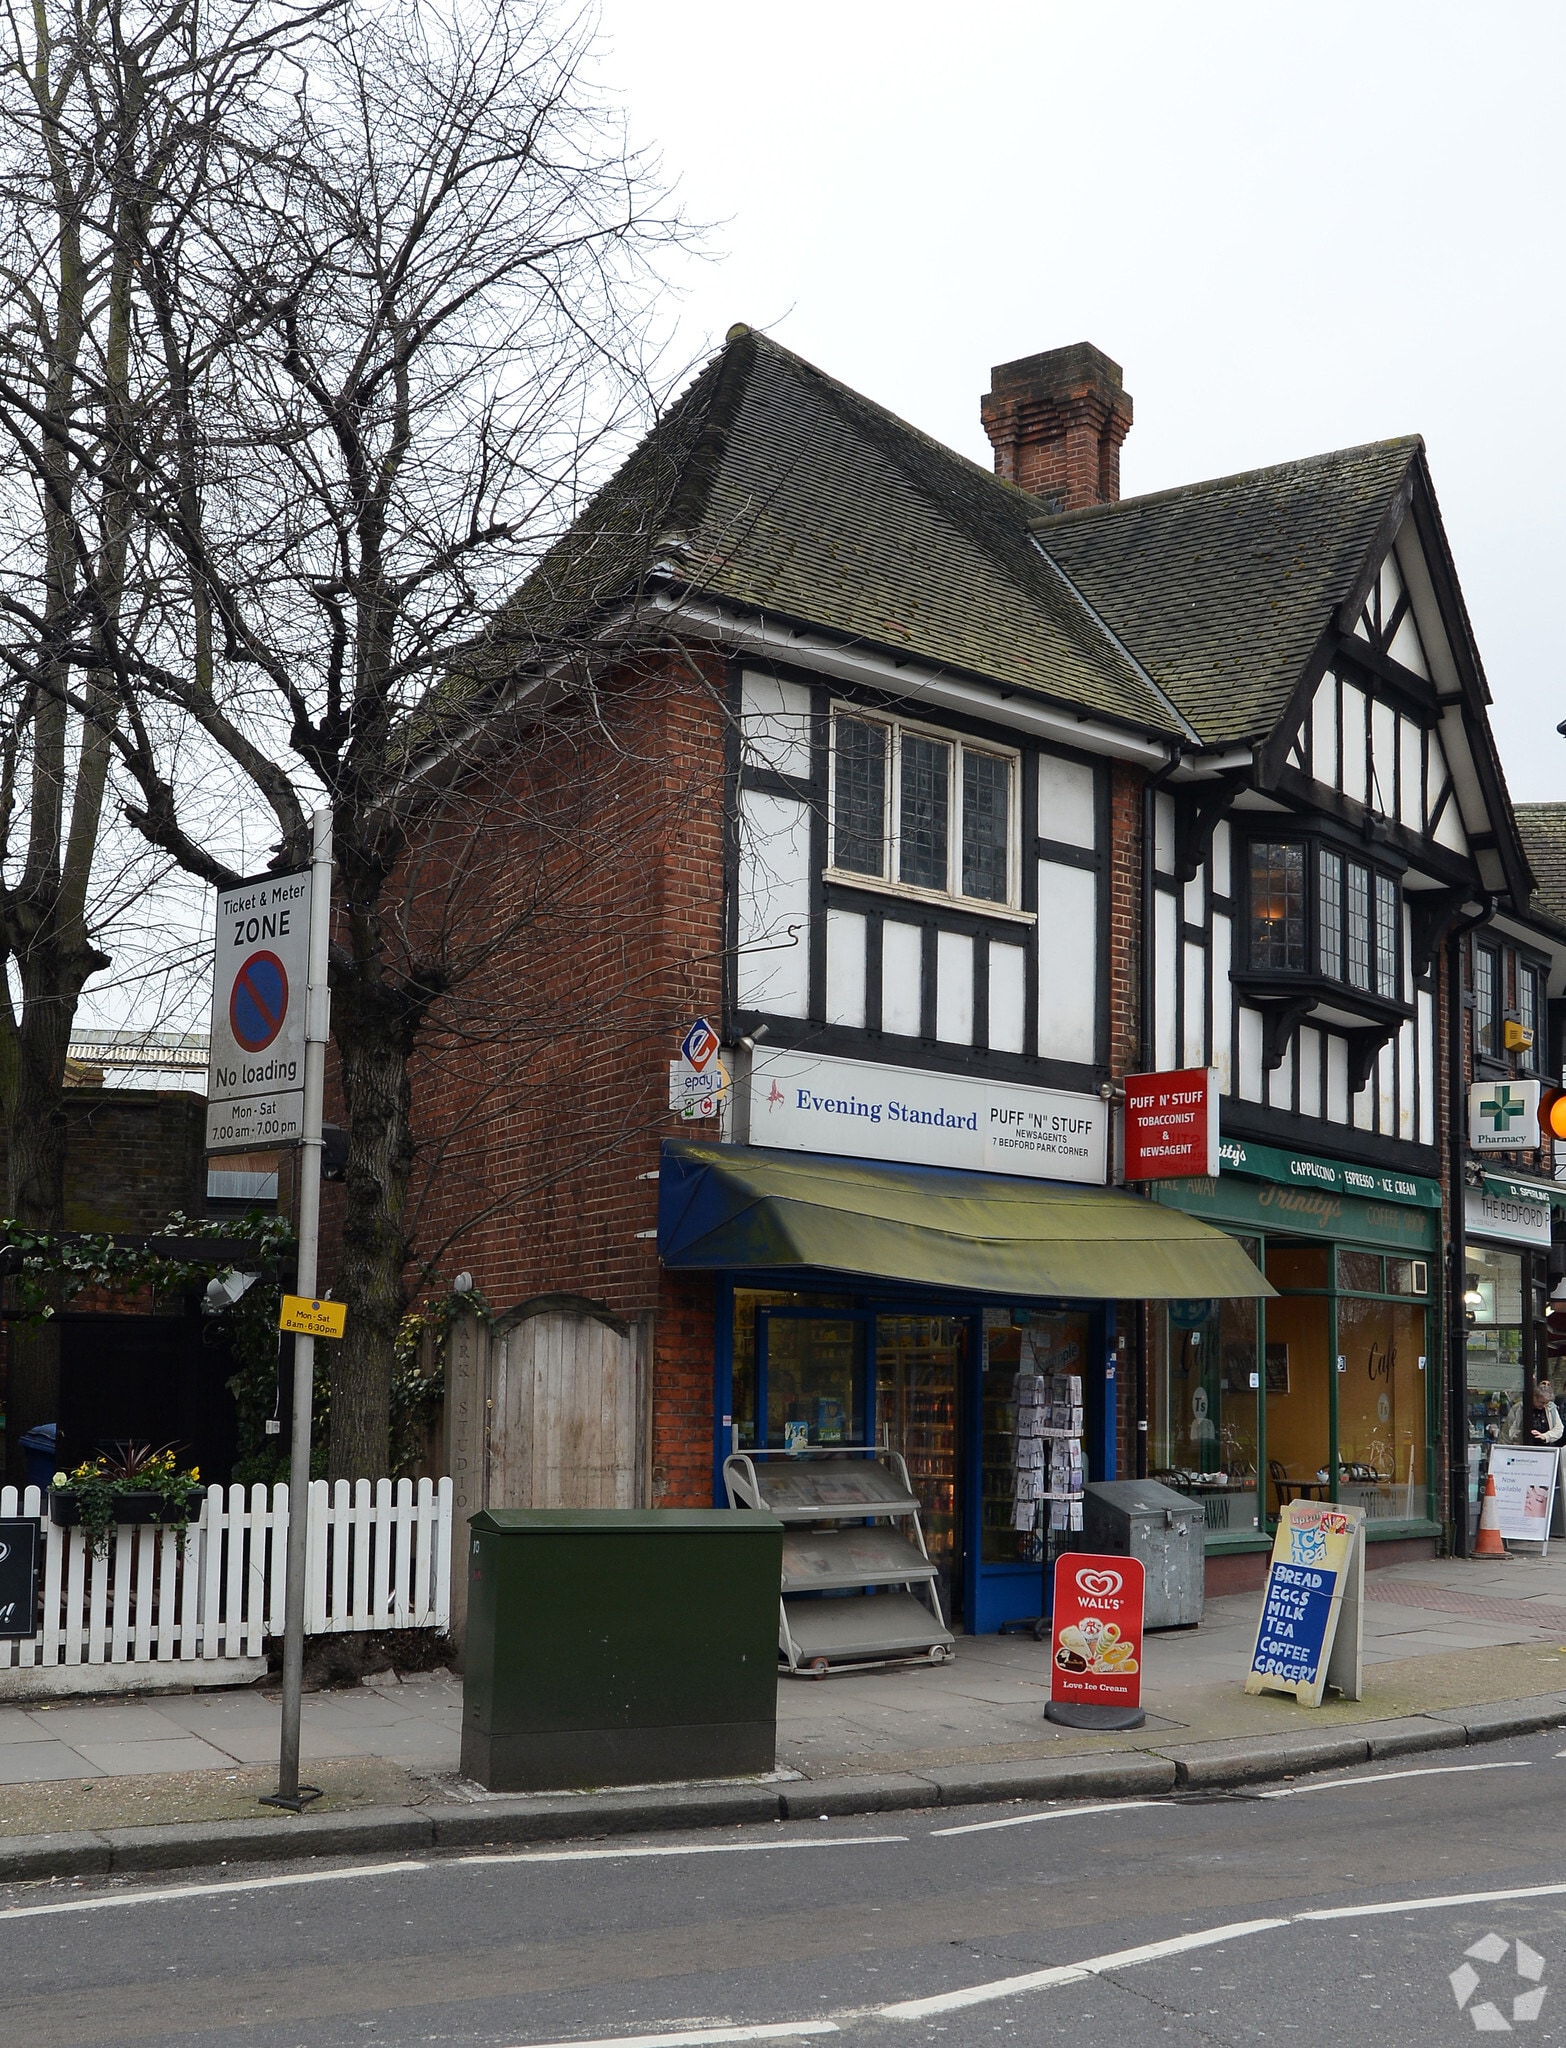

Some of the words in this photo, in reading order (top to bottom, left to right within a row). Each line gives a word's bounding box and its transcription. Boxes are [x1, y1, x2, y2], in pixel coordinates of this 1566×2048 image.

[224, 894, 256, 915] Ticket
[260, 891, 267, 906] &
[272, 885, 305, 903] Meter
[234, 910, 290, 946] ZONE
[216, 1067, 237, 1088] No
[243, 1060, 297, 1084] loading
[685, 1074, 713, 1091] epay
[232, 1106, 252, 1119] Mon
[260, 1101, 276, 1115] Sat
[796, 1089, 882, 1123] Evening
[888, 1101, 978, 1131] Standard
[1130, 1096, 1155, 1109] PUFF
[1172, 1091, 1203, 1105] STUFF
[990, 1108, 1025, 1126] PUFF
[1052, 1116, 1093, 1135] STUFF
[1137, 1112, 1195, 1127] TOBACCONIST
[212, 1126, 234, 1140] 7.00
[235, 1127, 250, 1138] am
[257, 1120, 279, 1135] 7.00
[281, 1121, 297, 1135] pm
[1016, 1129, 1067, 1144] NEWSAGENTS
[1162, 1131, 1169, 1140] &
[1478, 1134, 1526, 1145] Pharmacy
[992, 1137, 997, 1146] 7
[999, 1138, 1035, 1151] BEDFORD
[1036, 1143, 1057, 1153] PARK
[1058, 1145, 1089, 1157] CORNER
[1140, 1144, 1192, 1157] NEWSAGENT
[1291, 1160, 1335, 1182] CAPPUCCINO
[1345, 1171, 1375, 1189] ESPRESSO
[1382, 1178, 1393, 1192] ICE
[1394, 1181, 1417, 1196] CREAM
[1187, 1179, 1218, 1198] AWAY
[1510, 1186, 1519, 1195] D.
[1367, 1206, 1399, 1228] COFFEE
[1403, 1209, 1427, 1232] SHOP
[1482, 1198, 1498, 1219] THE
[1501, 1202, 1543, 1228] BEDFORD
[296, 1311, 312, 1320] Mon
[317, 1314, 330, 1322] Sat
[1368, 1340, 1398, 1384] Café
[1194, 1396, 1206, 1412] Ts
[1274, 1565, 1323, 1588] BREAD
[1078, 1596, 1120, 1610] WALL'S
[1271, 1585, 1311, 1606] EGGS
[1267, 1601, 1304, 1621] MILK
[1266, 1616, 1294, 1639] TEA
[1260, 1636, 1311, 1663] COFFEE
[1254, 1655, 1317, 1682] GROCERY
[1063, 1681, 1083, 1690] Love
[1084, 1682, 1098, 1691] Ice
[1100, 1684, 1128, 1693] Cream
